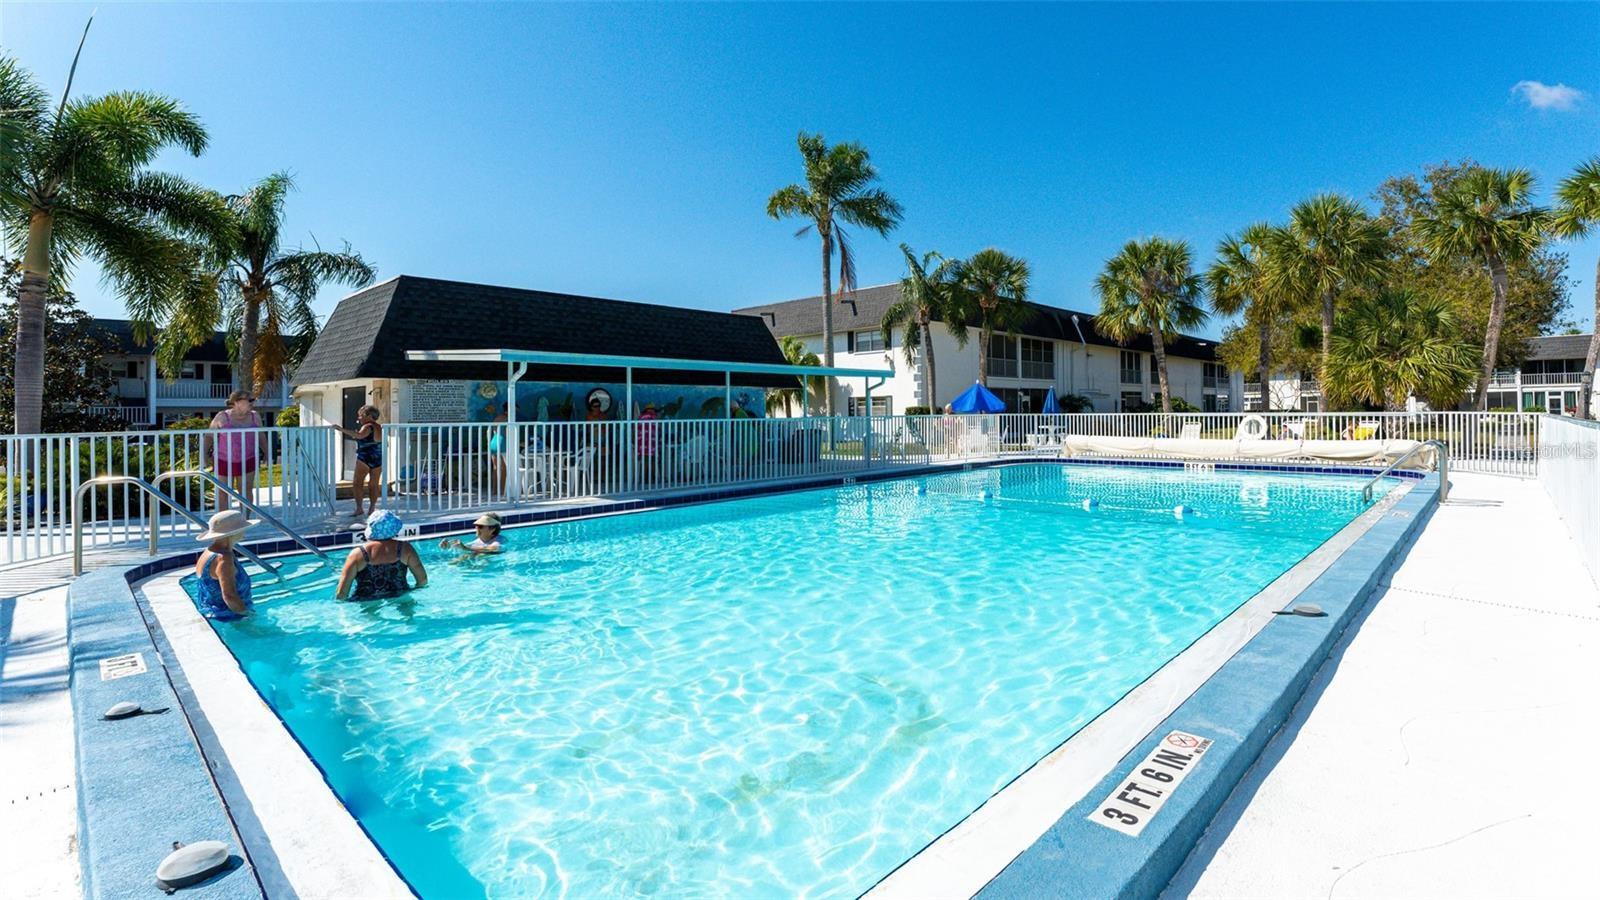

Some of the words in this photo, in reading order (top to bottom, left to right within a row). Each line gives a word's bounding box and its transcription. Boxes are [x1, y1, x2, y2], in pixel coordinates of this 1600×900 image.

[404, 528, 416, 537] IN
[1151, 748, 1194, 771] IN.
[1141, 768, 1174, 783] 6
[1116, 782, 1163, 810] FT.
[1103, 808, 1139, 825] 3
